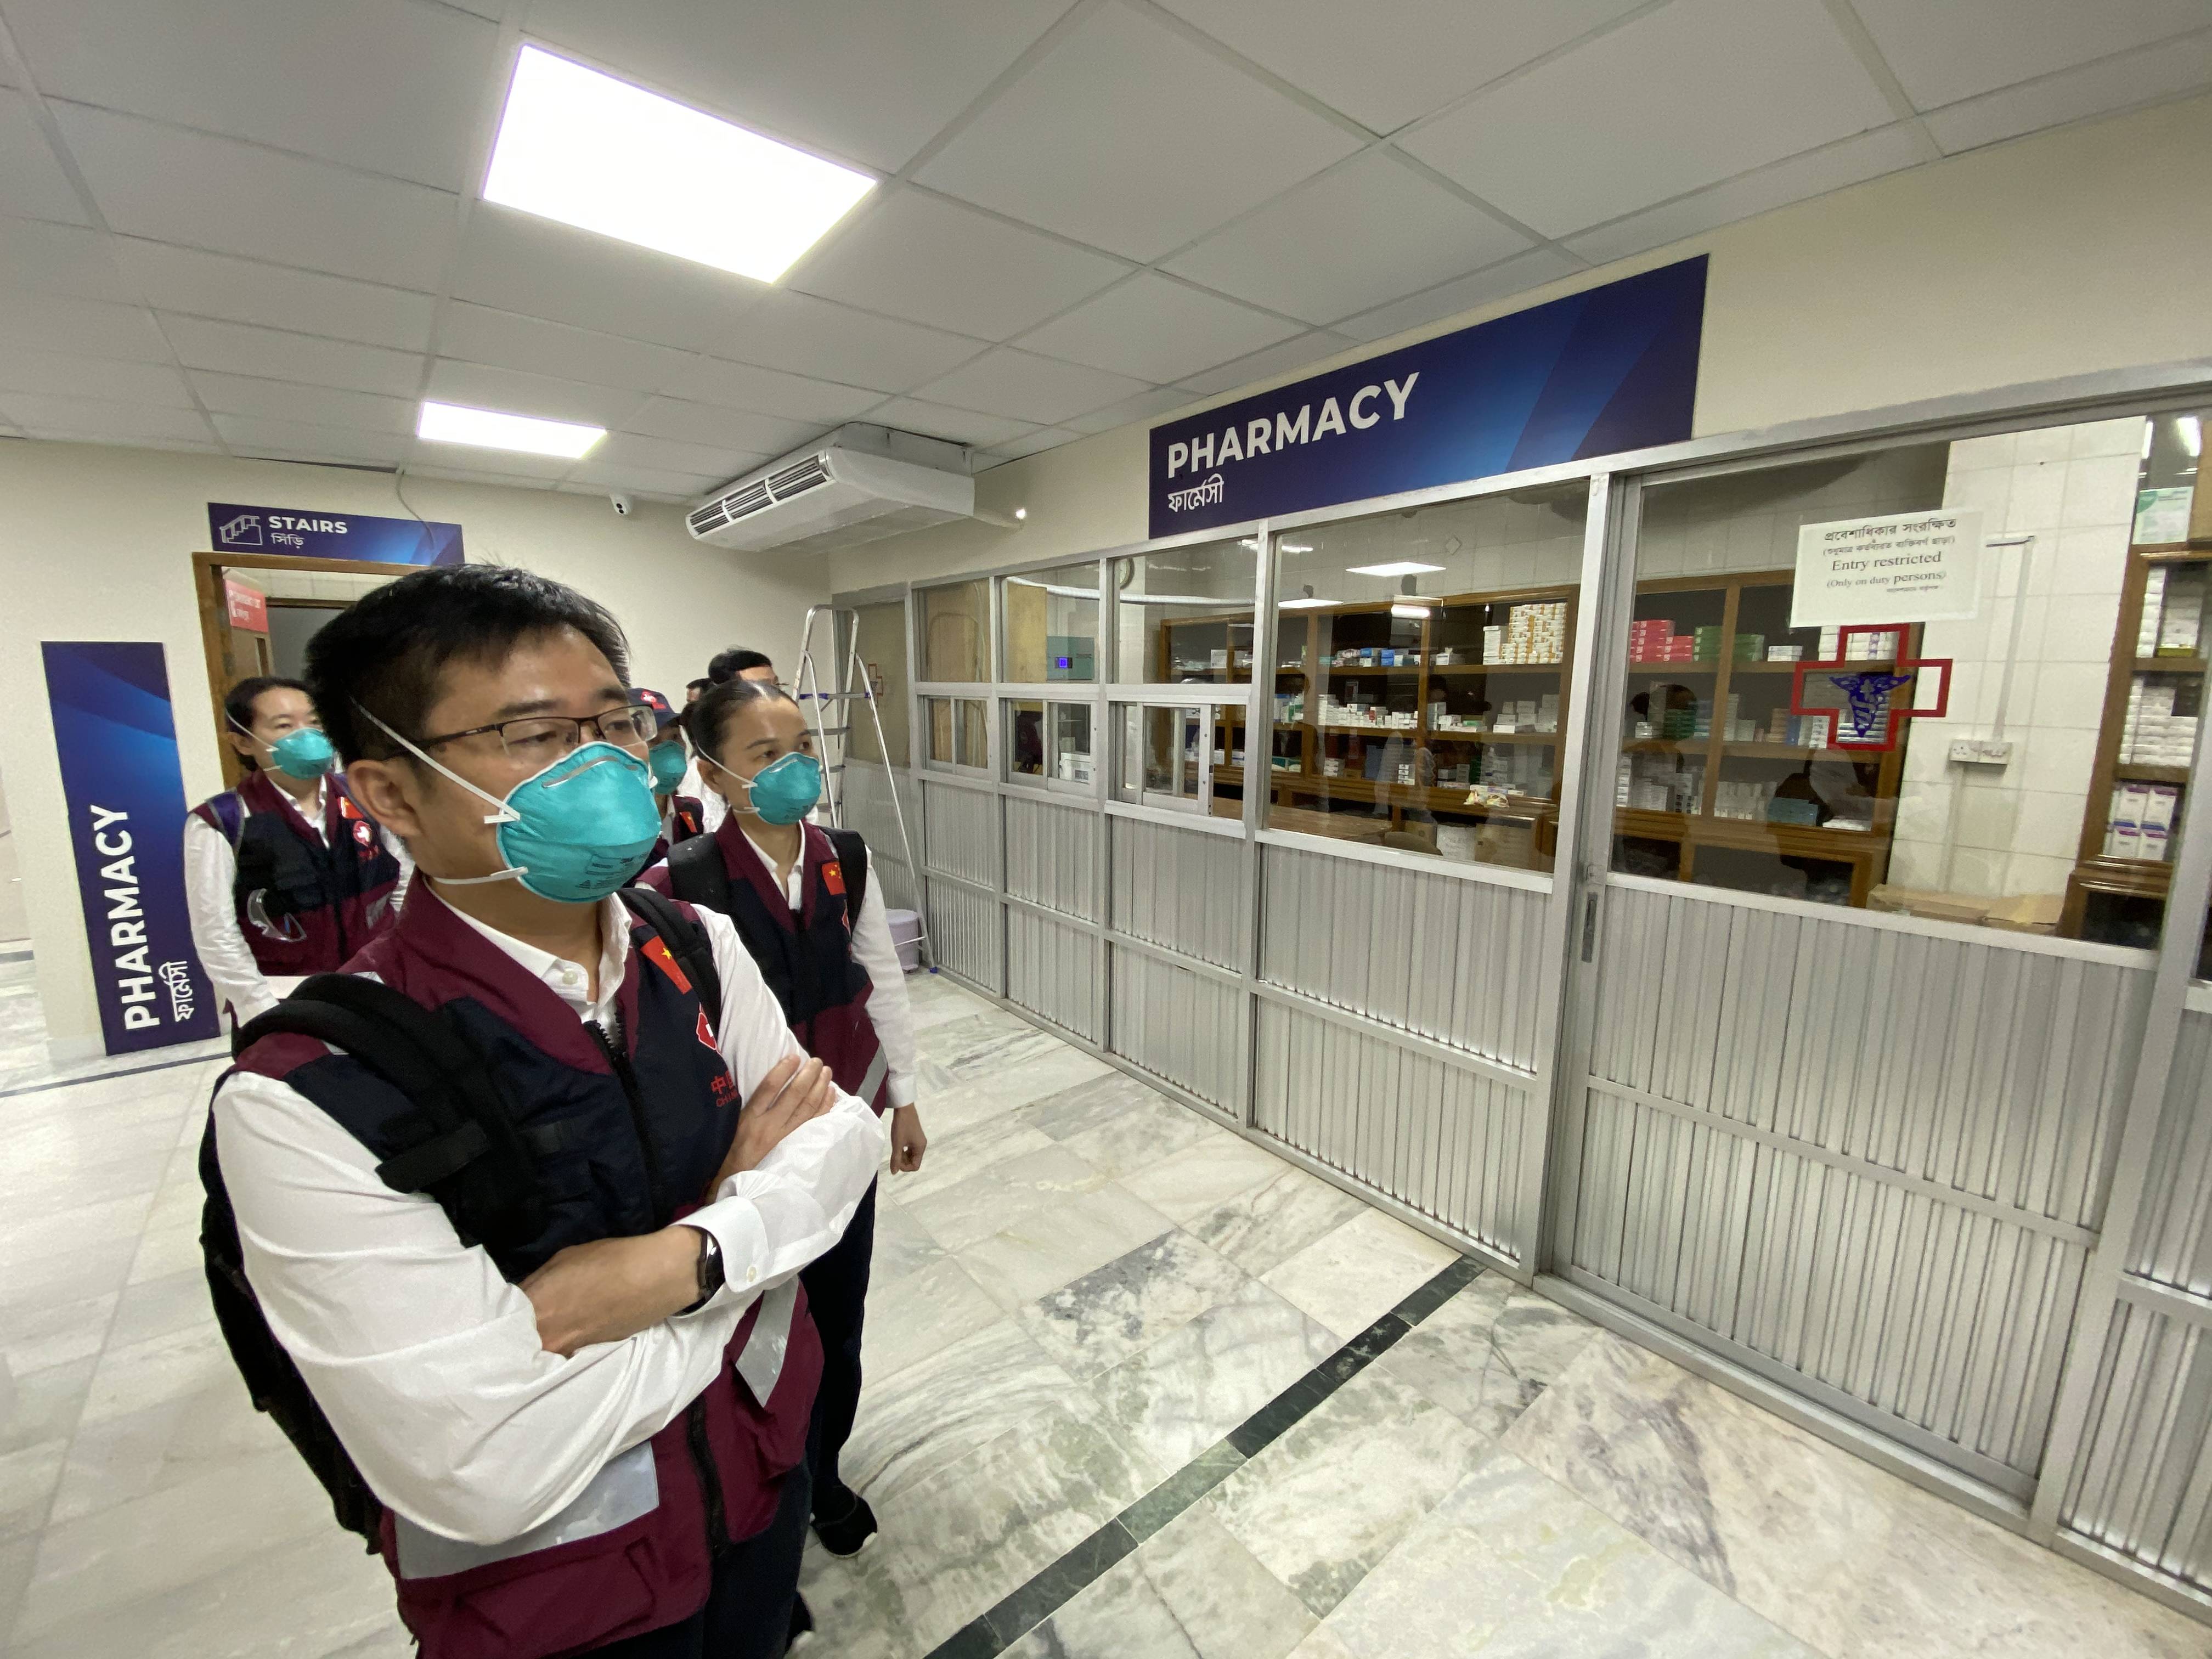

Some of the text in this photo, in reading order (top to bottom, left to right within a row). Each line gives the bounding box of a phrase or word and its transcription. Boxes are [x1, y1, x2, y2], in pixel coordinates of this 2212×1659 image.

[1168, 372, 1420, 478] PHARMACY
[1167, 473, 1224, 512] ফার্মেসী
[268, 516, 348, 534] STAIRS
[1903, 518, 1956, 534] সংরক্ষিত
[1832, 551, 1942, 572] Entry restricted
[1827, 579, 1852, 589] (Only
[1870, 576, 1891, 585] duty
[1894, 570, 1947, 585] persons)
[90, 804, 160, 1030] PHARMACY
[158, 961, 194, 1022] ফার্মেসী
